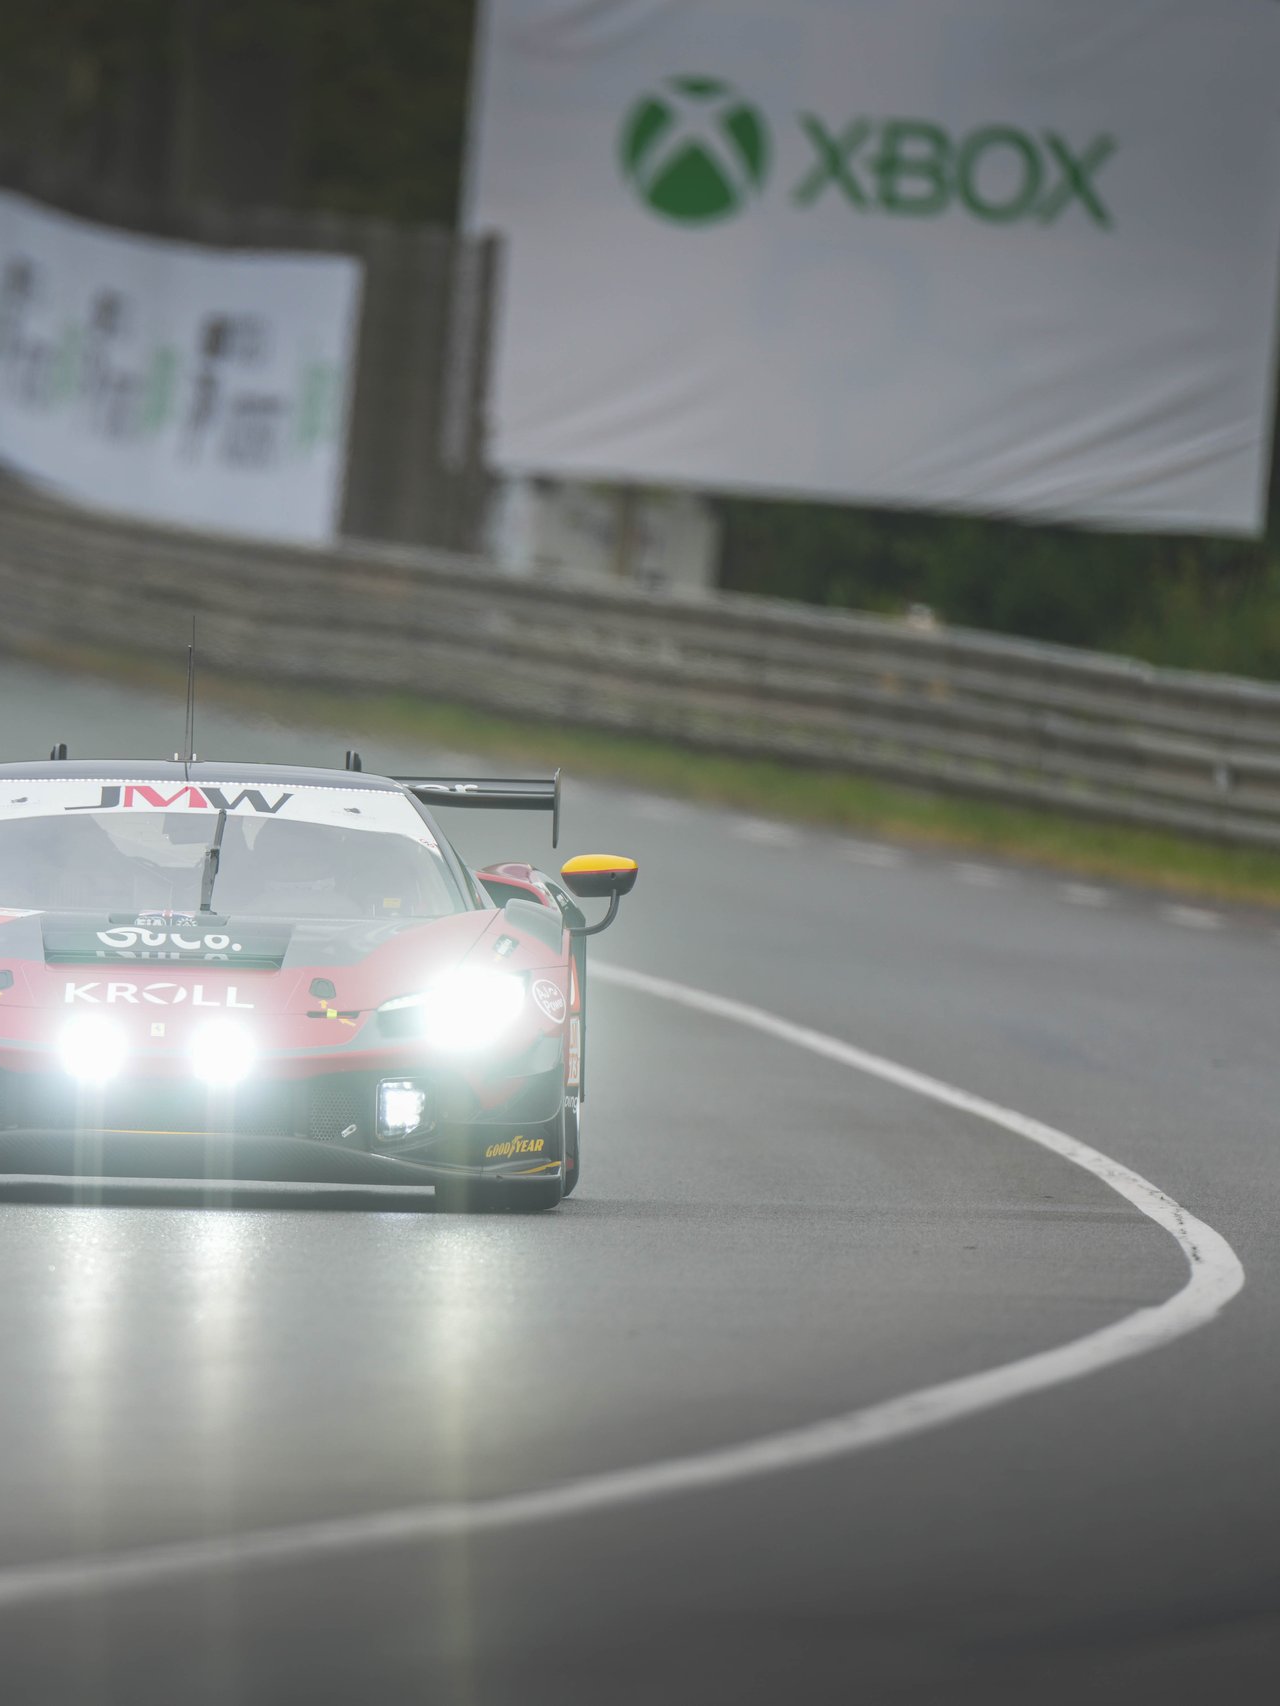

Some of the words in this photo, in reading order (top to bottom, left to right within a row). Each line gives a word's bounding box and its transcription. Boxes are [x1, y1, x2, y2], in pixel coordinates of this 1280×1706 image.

[792, 109, 1116, 232] XBOX
[64, 785, 294, 813] JMW
[64, 982, 254, 1009] KROLL
[485, 1135, 544, 1159] GOODYEAR
